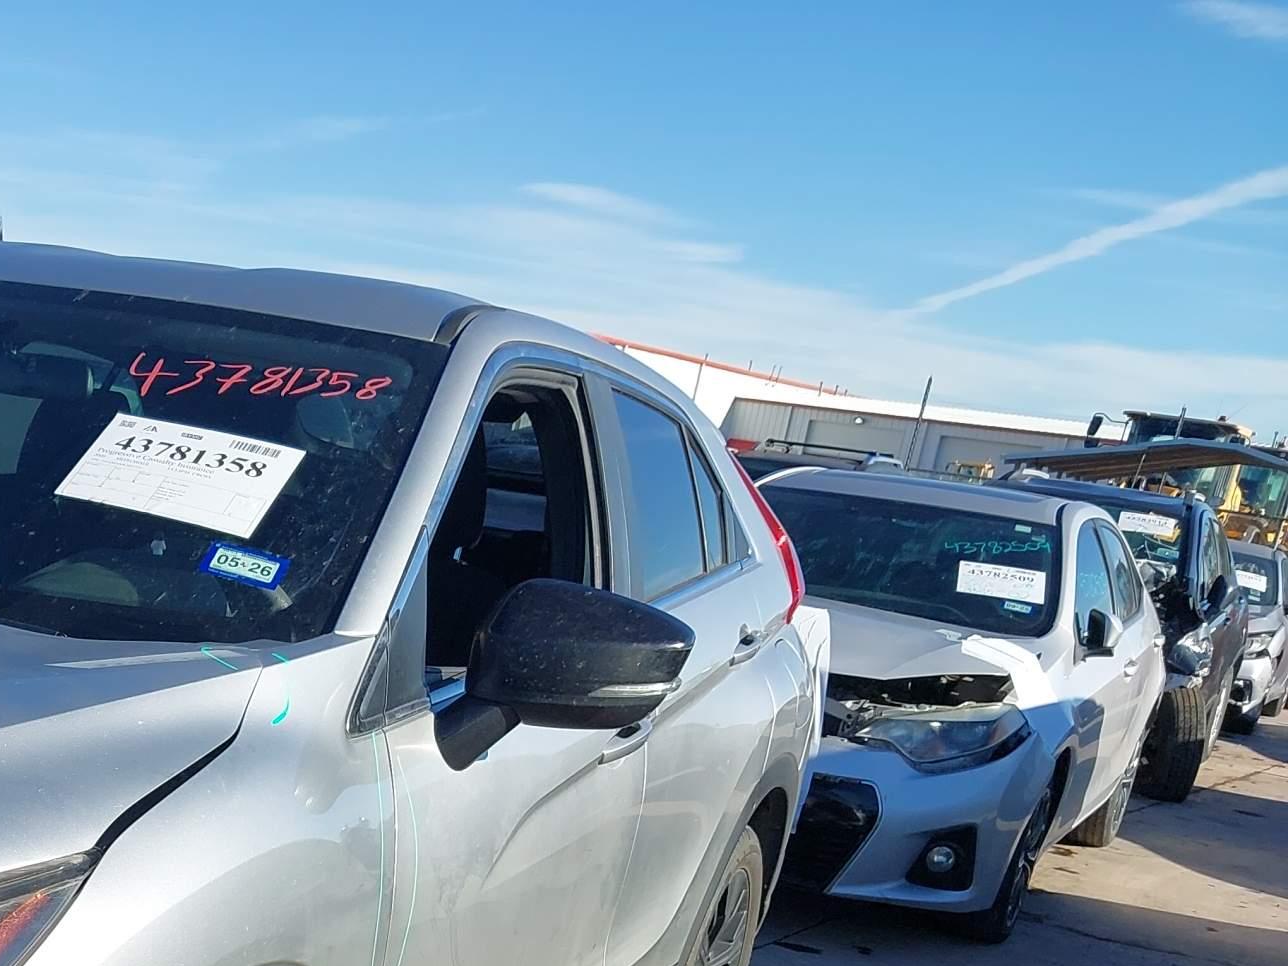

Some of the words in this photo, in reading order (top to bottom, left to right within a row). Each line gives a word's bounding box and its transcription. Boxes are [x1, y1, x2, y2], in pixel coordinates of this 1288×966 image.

[129, 352, 393, 400] 43781358
[114, 435, 268, 479] 43781358
[216, 554, 240, 568] 05
[247, 562, 273, 577] 26
